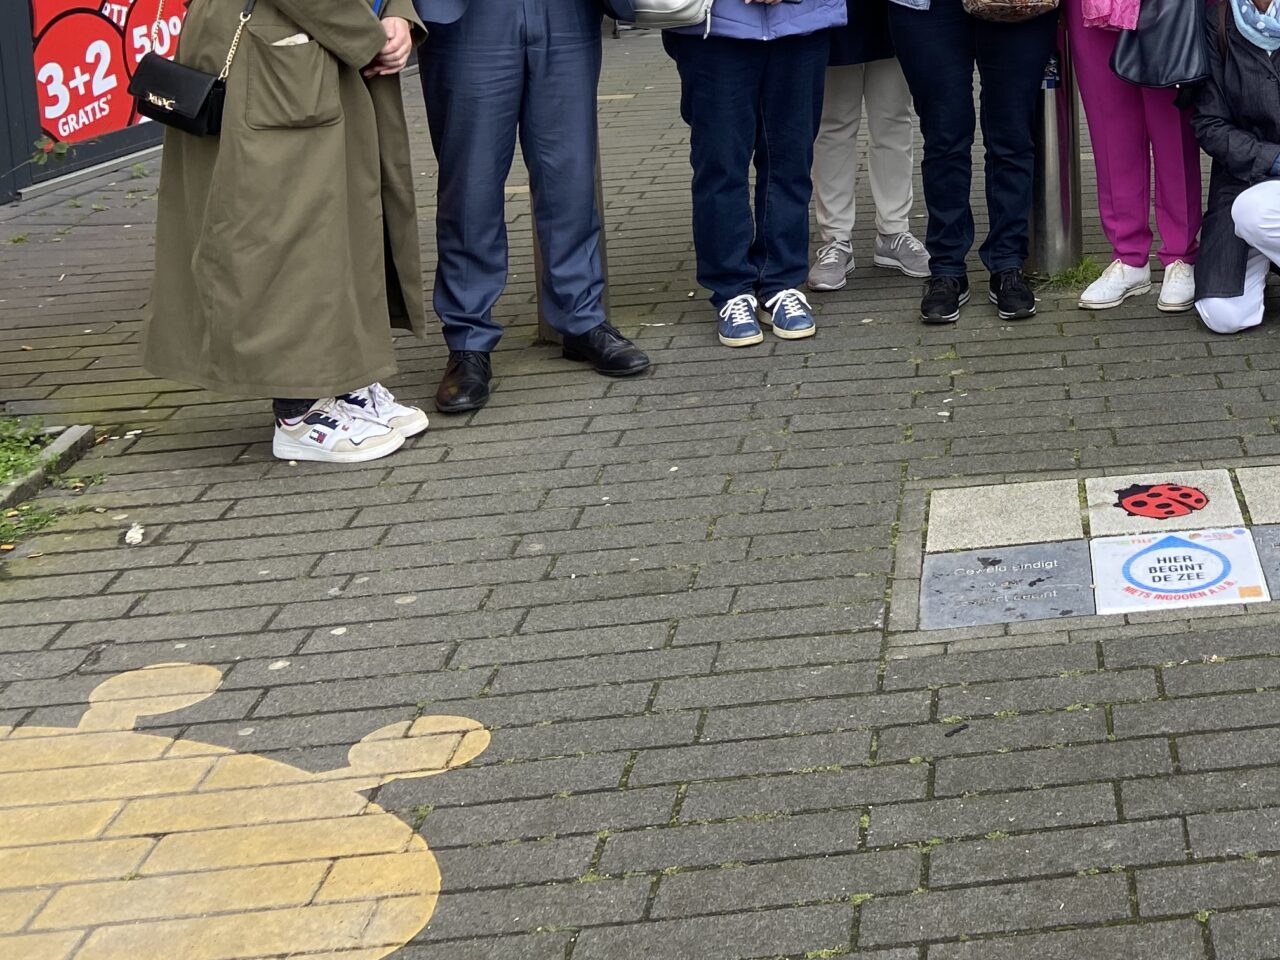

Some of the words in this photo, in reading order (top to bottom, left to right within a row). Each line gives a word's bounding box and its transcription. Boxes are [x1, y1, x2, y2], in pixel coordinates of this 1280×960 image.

[37, 40, 118, 119] 3+2
[1157, 555, 1193, 564] HIER
[1149, 563, 1205, 574] BEGINT
[1152, 575, 1172, 583] DE
[1178, 572, 1206, 581] ZEE
